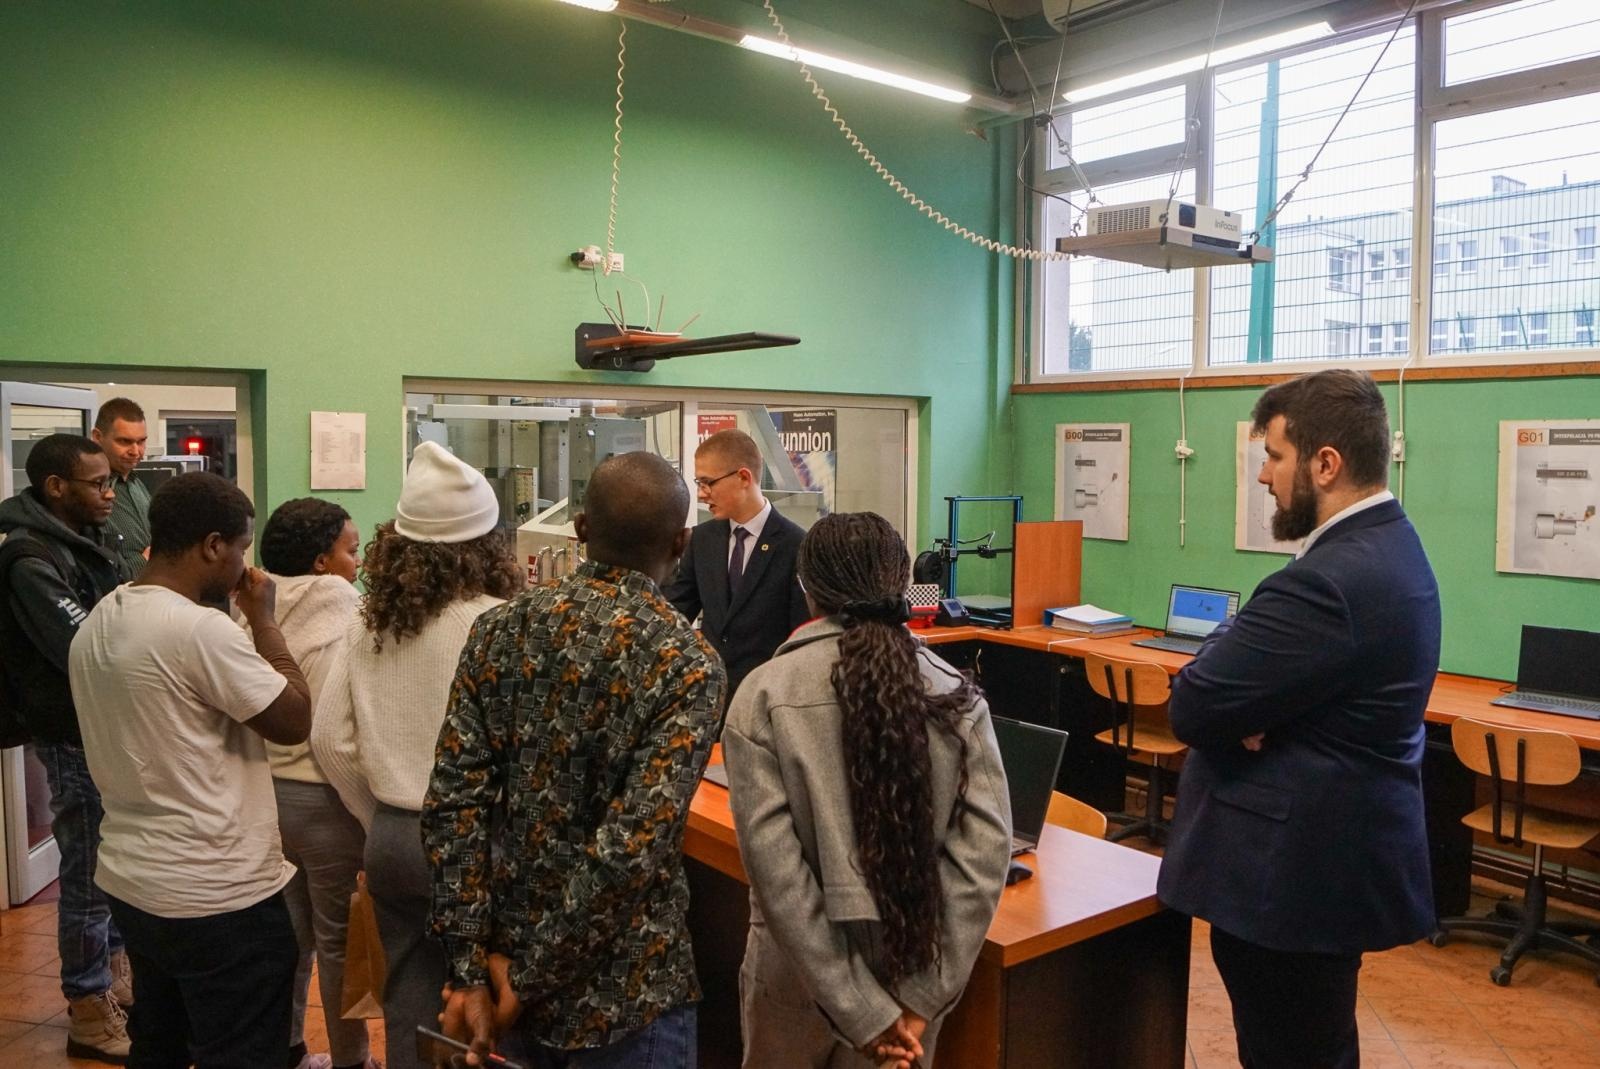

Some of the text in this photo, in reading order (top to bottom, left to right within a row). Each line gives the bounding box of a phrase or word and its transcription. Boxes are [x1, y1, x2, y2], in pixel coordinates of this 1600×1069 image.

[1215, 220, 1238, 232] InFocus
[778, 425, 831, 451] unnion
[1519, 431, 1543, 443] G01
